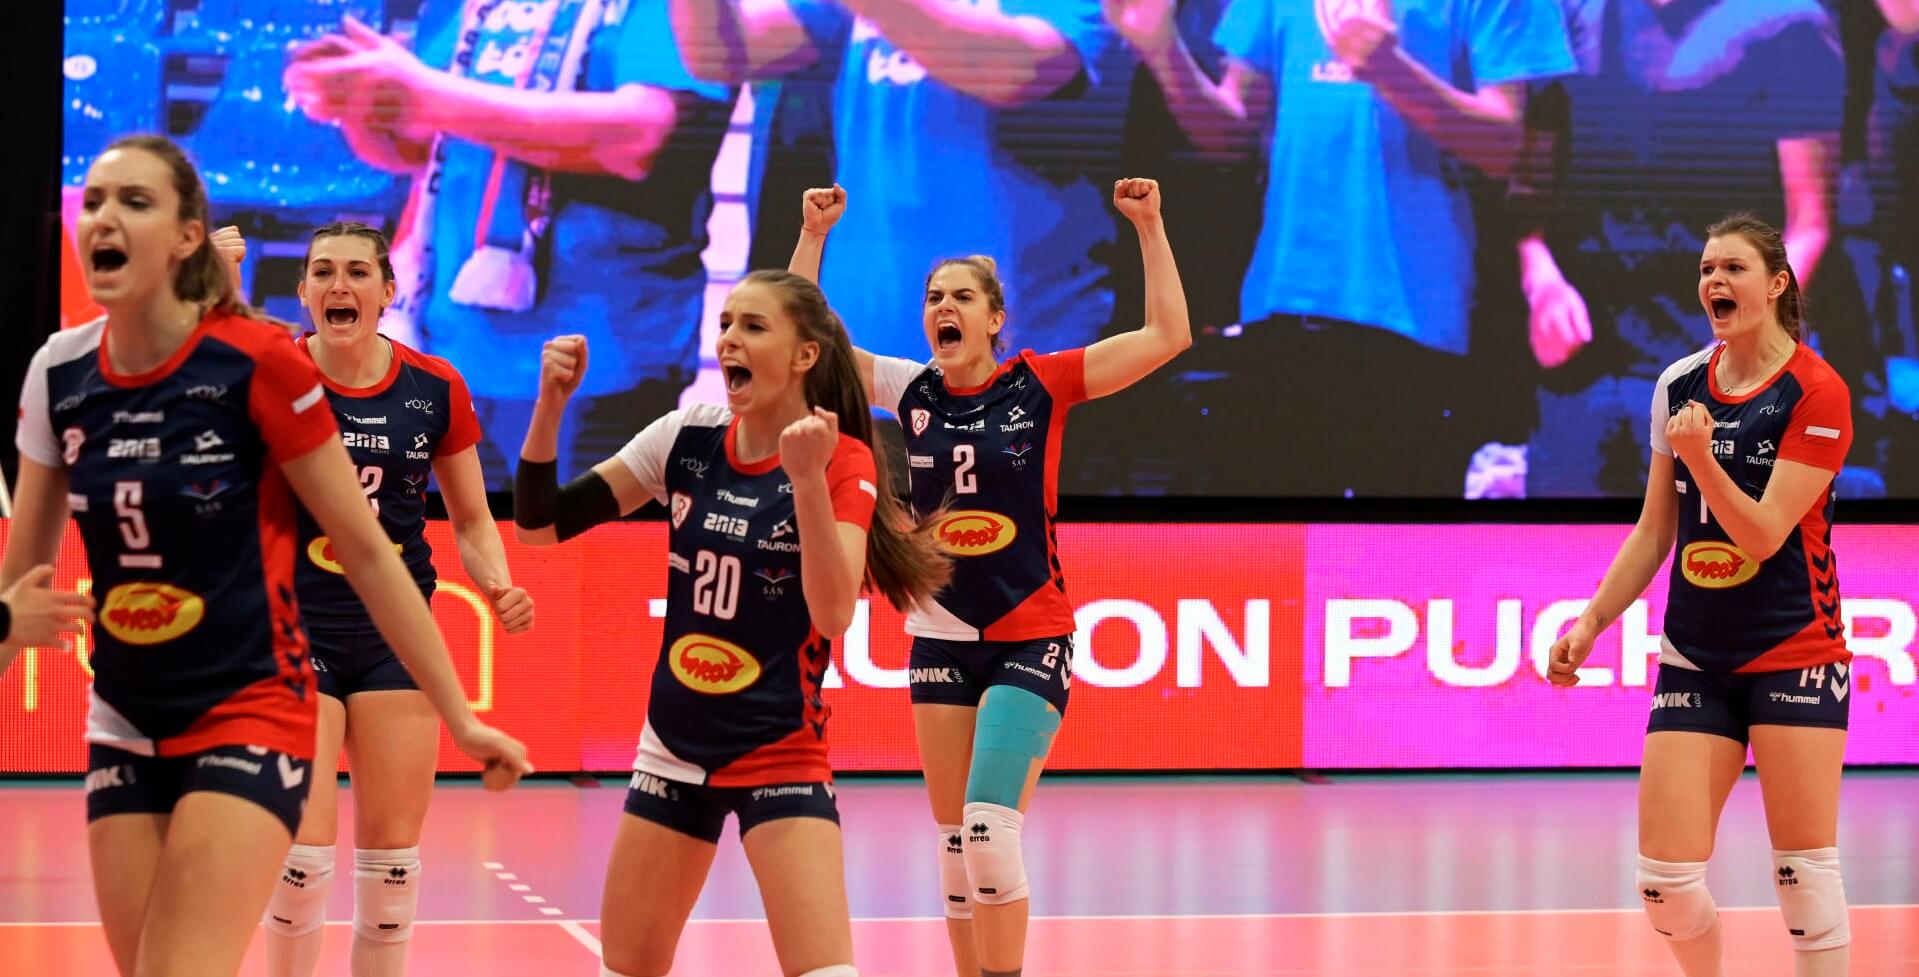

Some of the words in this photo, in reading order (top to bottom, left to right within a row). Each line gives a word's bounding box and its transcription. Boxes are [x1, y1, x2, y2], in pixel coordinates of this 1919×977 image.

[1000, 421, 1034, 433] TAURON
[953, 444, 977, 494] 2
[1746, 455, 1776, 467] TAURO
[114, 480, 150, 550] 5
[693, 550, 741, 620] 20
[1042, 642, 1060, 669] 2
[1014, 662, 1052, 681] hummel
[1800, 664, 1826, 689] 14
[1781, 692, 1821, 705] hummel
[764, 785, 813, 797] hummel
